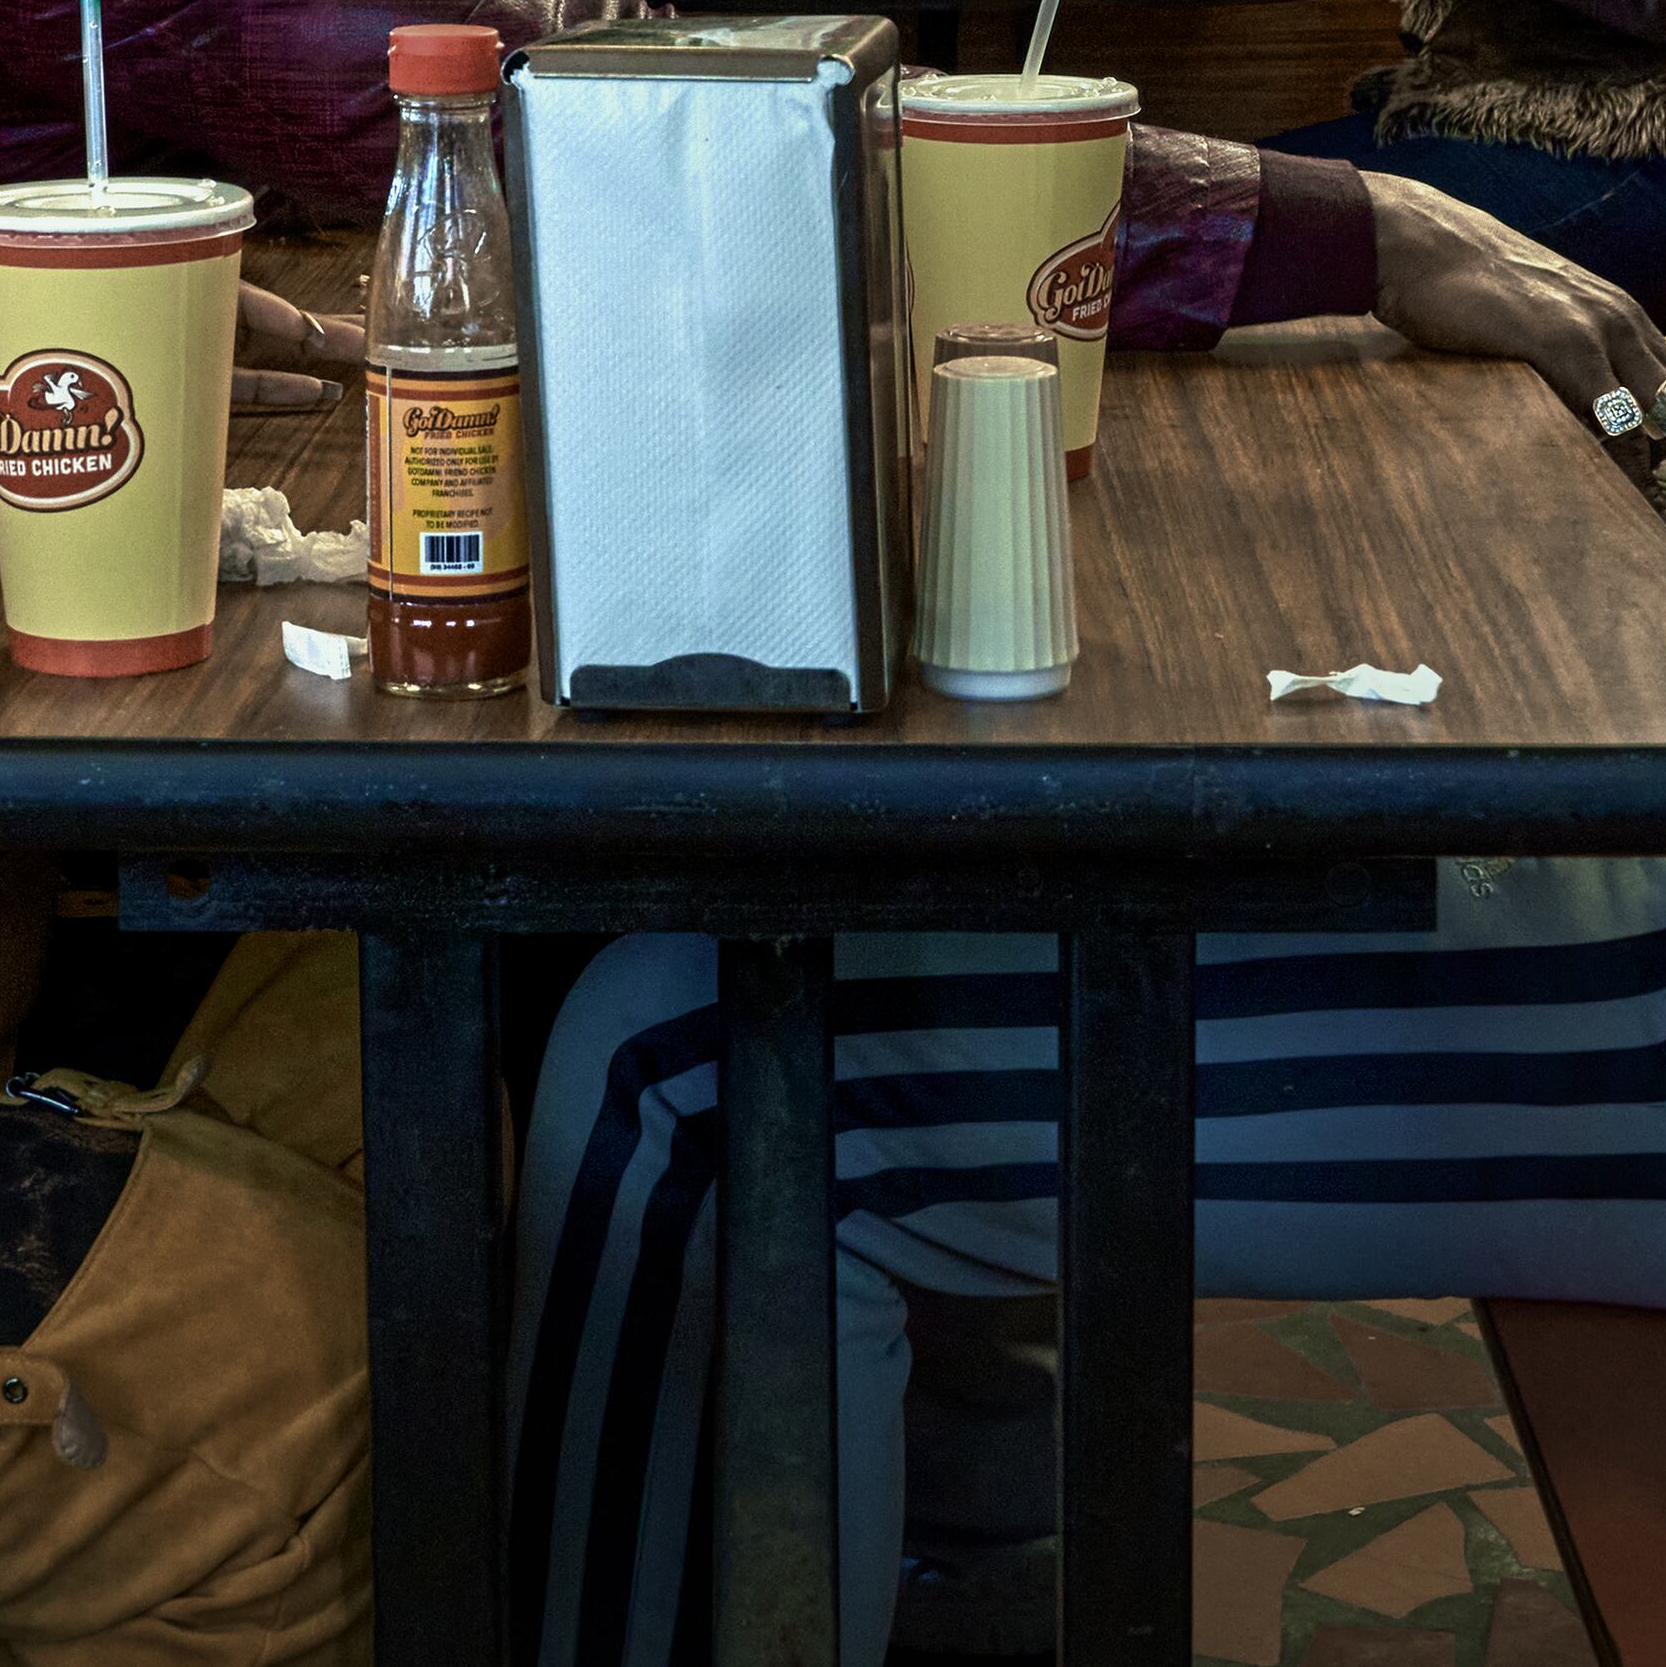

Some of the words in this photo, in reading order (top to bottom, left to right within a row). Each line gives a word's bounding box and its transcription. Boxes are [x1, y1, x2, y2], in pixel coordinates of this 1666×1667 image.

[1072, 299, 1102, 322] FRIED
[424, 431, 451, 440] FRIED
[455, 428, 494, 439] CHICKEN
[424, 447, 437, 455] FOR
[439, 446, 476, 455] INDIVIDUAL
[32, 453, 112, 477] CHICKEN
[405, 457, 445, 466] AUTHORIZED
[447, 457, 463, 466] ONLY
[465, 456, 477, 464] FOR
[412, 478, 443, 486] COMPANY
[444, 479, 458, 487] AND
[413, 509, 455, 518] PROPRIETARY
[457, 508, 479, 517] RECIPE
[480, 507, 493, 516] NOT
[425, 520, 435, 529] TO
[436, 520, 444, 528] BE
